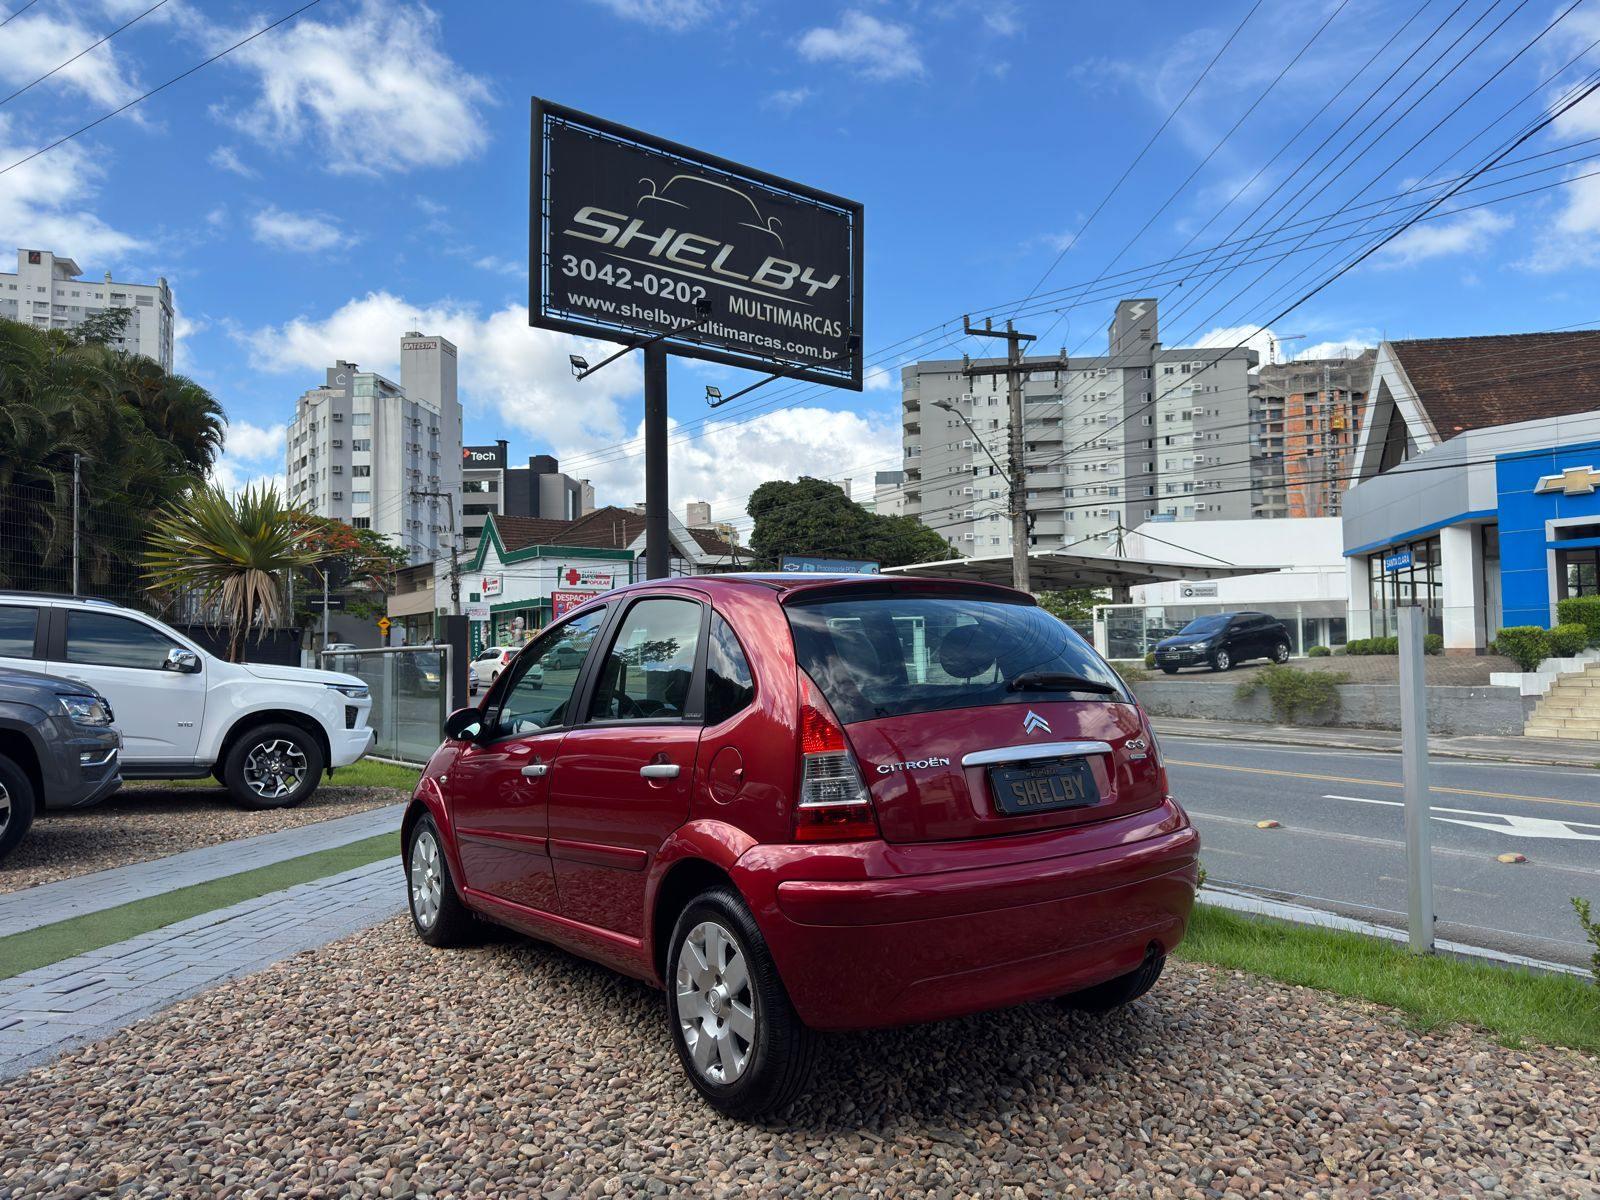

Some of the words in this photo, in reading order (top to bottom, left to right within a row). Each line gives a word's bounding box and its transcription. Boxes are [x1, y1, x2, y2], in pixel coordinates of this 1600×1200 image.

[562, 206, 841, 297] SHELBY
[728, 295, 842, 338] MULTIMARCAS
[470, 452, 496, 461] Tech
[555, 593, 598, 602] DESPACHA
[876, 756, 951, 774] CITROËN
[1010, 774, 1086, 806] SHELBY
